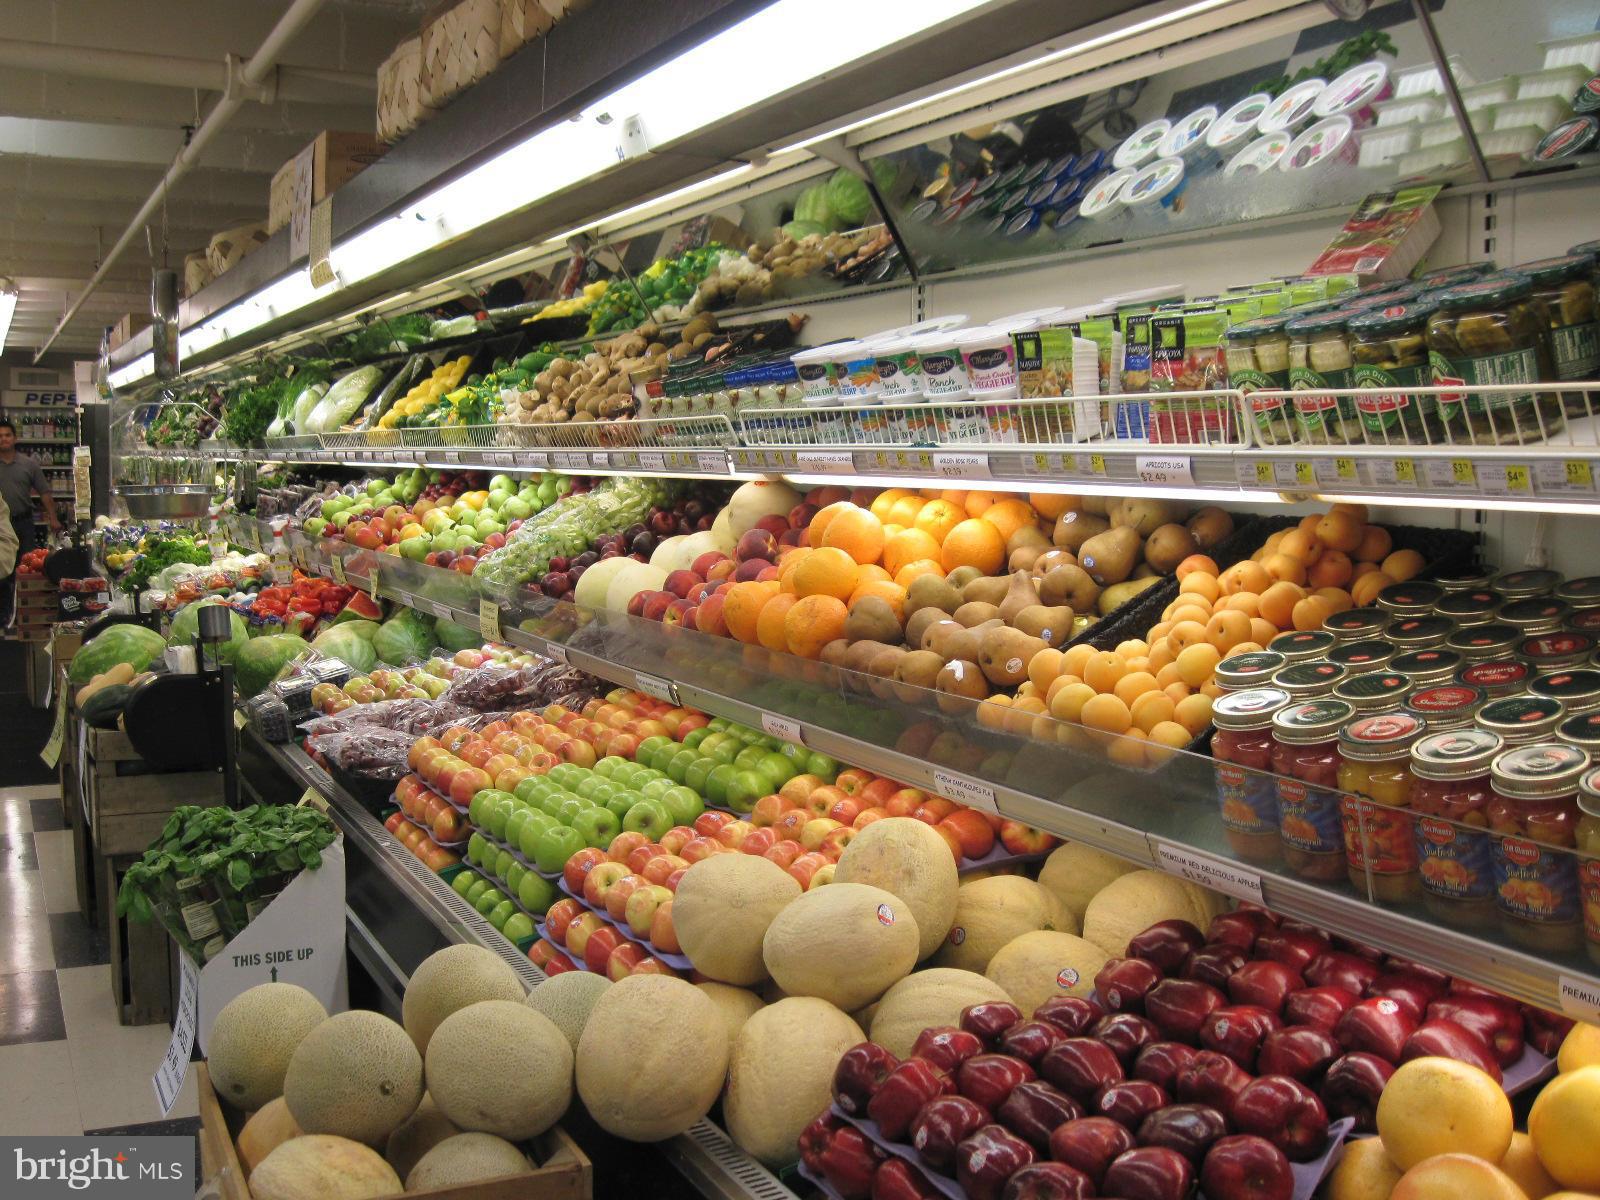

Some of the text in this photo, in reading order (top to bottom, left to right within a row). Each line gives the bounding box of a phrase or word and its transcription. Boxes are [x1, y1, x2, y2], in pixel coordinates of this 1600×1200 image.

[928, 375, 956, 388] Ranch
[1145, 461, 1185, 469] APRICOTS USA
[1140, 471, 1167, 482] $2.49
[1159, 850, 1260, 890] PREMIUM RED DELICIOUS APPLES
[232, 947, 314, 967] THIS SIDE UP
[1562, 984, 1600, 1007] PREMIU
